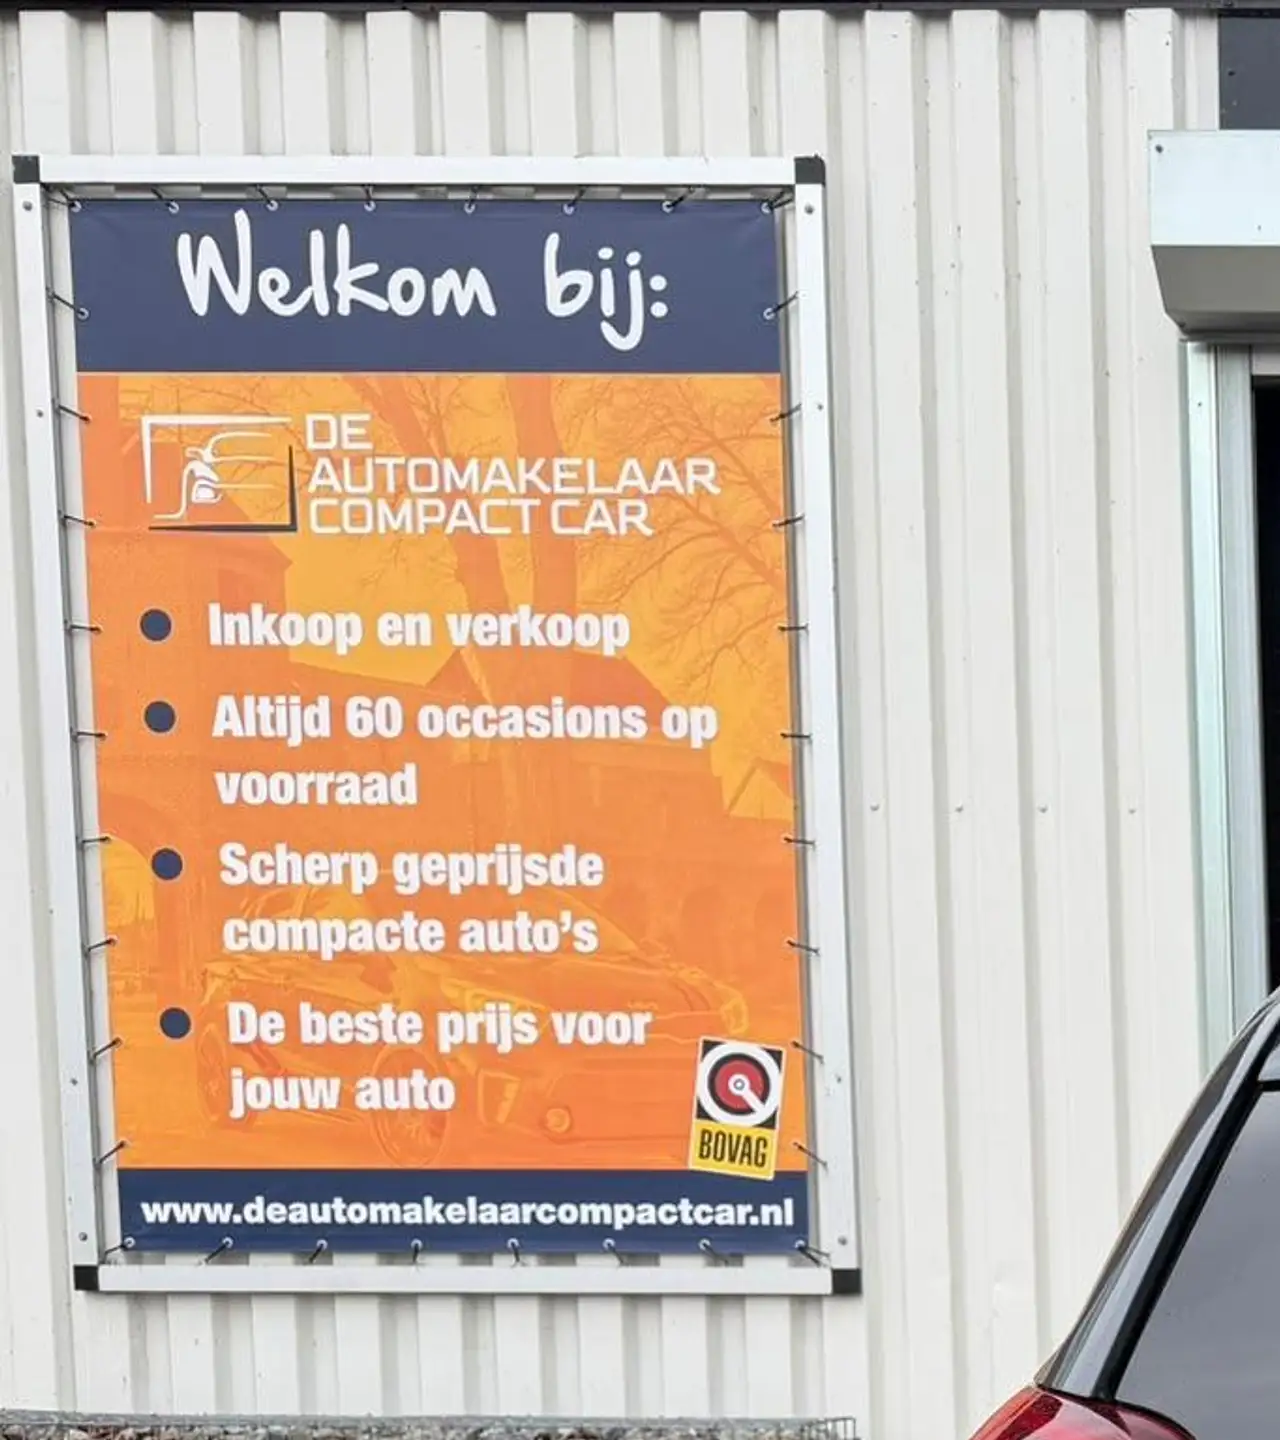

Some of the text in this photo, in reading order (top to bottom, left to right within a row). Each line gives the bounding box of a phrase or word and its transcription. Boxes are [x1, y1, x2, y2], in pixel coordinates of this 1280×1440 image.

[175, 209, 668, 351] Welkom bij:
[306, 413, 373, 451] DE
[308, 456, 721, 496] AUTOMAKELAAR
[309, 497, 654, 537] COMPACT CAR
[208, 603, 631, 657] Inkoop en verkoop
[212, 694, 718, 749] Altijd 60 occasions op
[215, 762, 418, 806] voorraad
[220, 842, 604, 896] Scherp geprijsde
[223, 910, 599, 961] compacte auto's
[228, 1001, 653, 1054] De beste prijs voor
[230, 1067, 456, 1119] jouw auto
[700, 1128, 768, 1167] BOVAG
[141, 1195, 794, 1231] www.deautomakelaarcompactcar.nl
